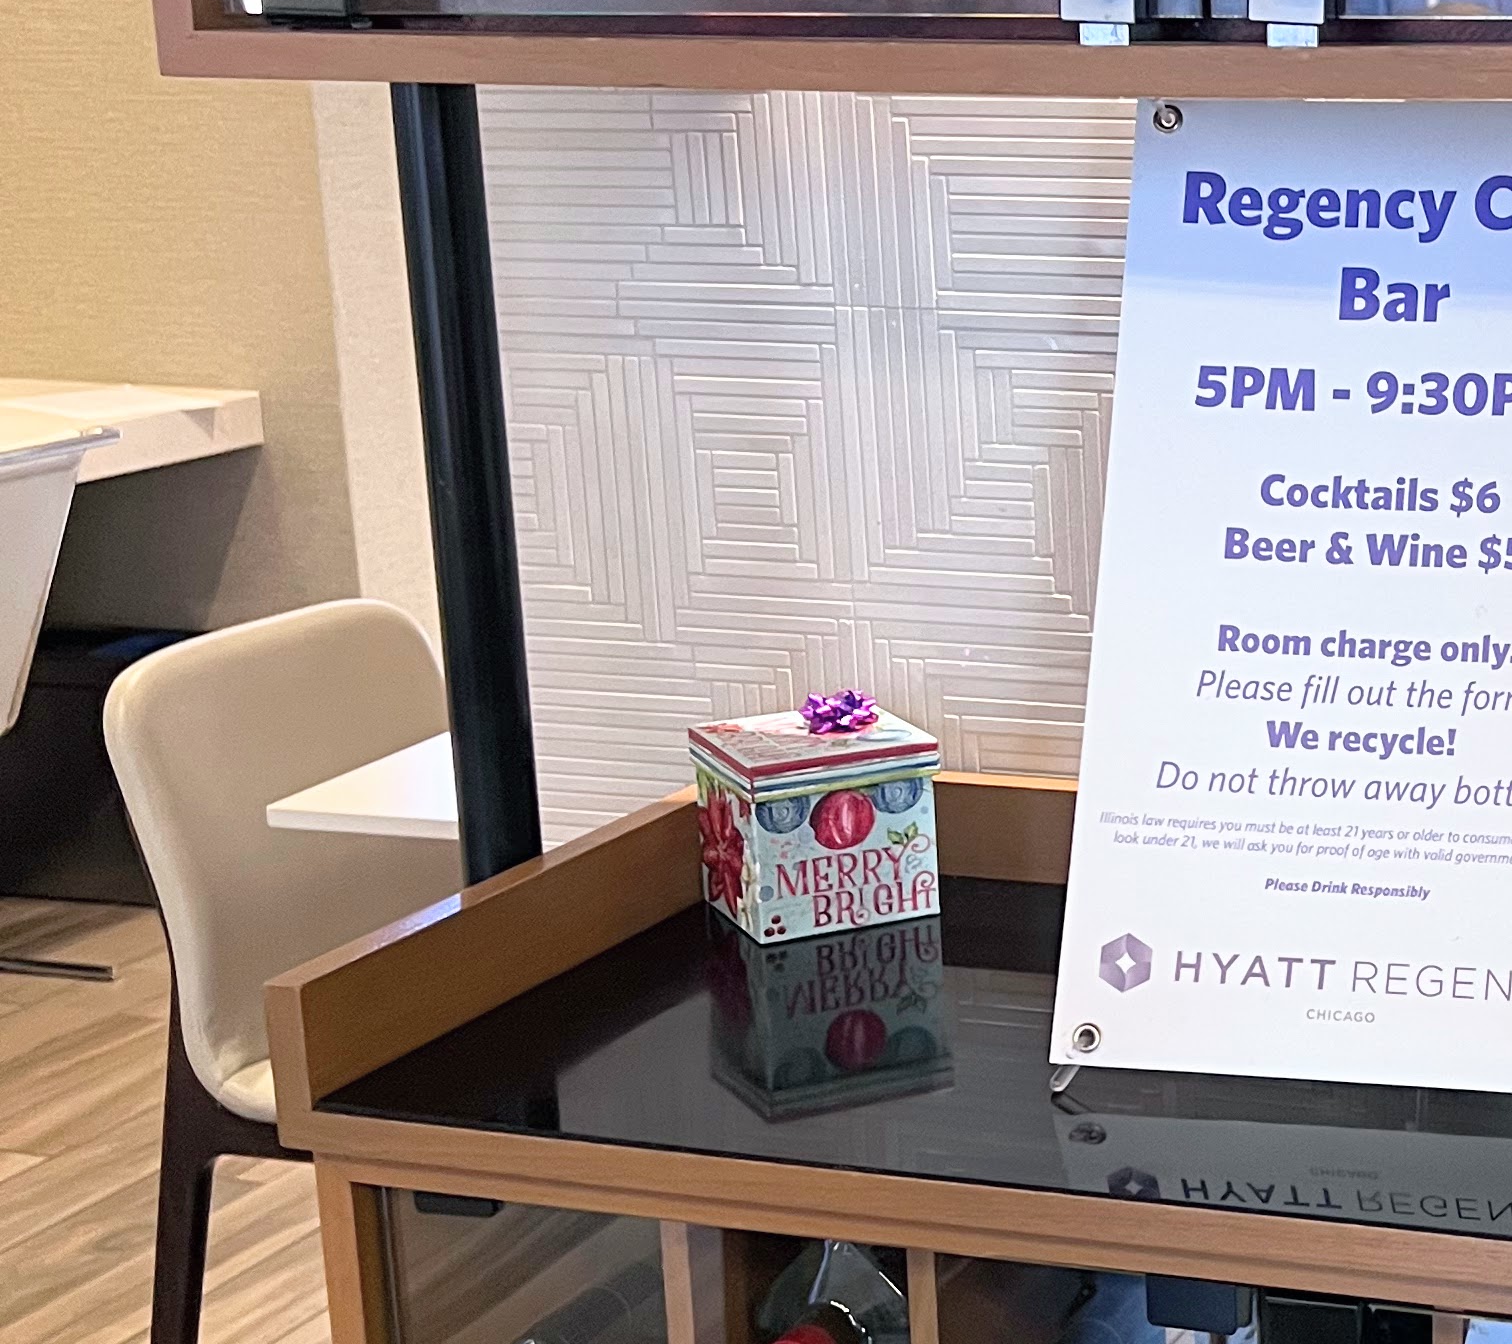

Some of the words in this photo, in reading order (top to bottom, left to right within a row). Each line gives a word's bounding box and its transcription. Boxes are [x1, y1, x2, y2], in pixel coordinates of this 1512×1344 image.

[1182, 171, 1457, 243] Regency
[1339, 266, 1451, 324] Bar
[1195, 365, 1316, 412] 5PM
[1332, 389, 1351, 400] -
[1260, 473, 1439, 513] Cocktails
[1449, 477, 1501, 515] $6
[1224, 527, 1315, 563] Beer
[1325, 531, 1354, 565] &
[1366, 533, 1467, 569] Wine
[1217, 624, 1312, 657] Room
[1320, 629, 1431, 665] charge
[1196, 670, 1292, 701] Please
[1301, 674, 1340, 708] fill
[1347, 679, 1397, 708] out
[1406, 679, 1453, 710] the
[1266, 720, 1319, 750] We
[1328, 725, 1457, 760] recycle!
[1156, 761, 1198, 790] Do
[1208, 766, 1259, 795] not
[1268, 767, 1356, 799] throw
[1363, 777, 1446, 810] away
[1099, 811, 1139, 826] Illinois
[1142, 813, 1165, 827] law
[1167, 816, 1217, 831] requires
[1219, 820, 1242, 834] you
[1245, 821, 1276, 834] must
[1279, 821, 1294, 835] be
[1297, 823, 1309, 836] at
[1312, 822, 1342, 837] least
[1344, 825, 1360, 838] 21
[1360, 828, 1394, 843] years
[1397, 830, 1411, 841] or
[1412, 829, 1445, 842] older
[1447, 831, 1460, 844] to
[1113, 830, 1140, 845] look
[1142, 833, 1180, 847] under
[1180, 835, 1198, 850] 21,
[1202, 839, 1220, 851] we
[1223, 837, 1246, 852] will
[1247, 839, 1268, 853] ask
[1270, 842, 1294, 856] you
[1295, 841, 1315, 857] for
[1315, 842, 1349, 859] proof
[1351, 844, 1365, 860] of
[1367, 848, 1390, 860] age
[1393, 846, 1420, 860] with
[1423, 848, 1453, 862] valid
[775, 846, 908, 900] MERRY
[1264, 877, 1308, 895] Please
[1311, 879, 1348, 896] Drink
[1350, 882, 1432, 902] Responsibly
[811, 870, 937, 928] BRIGHT
[1173, 950, 1337, 992] HYATT
[1306, 1008, 1376, 1024] CHICAGO
